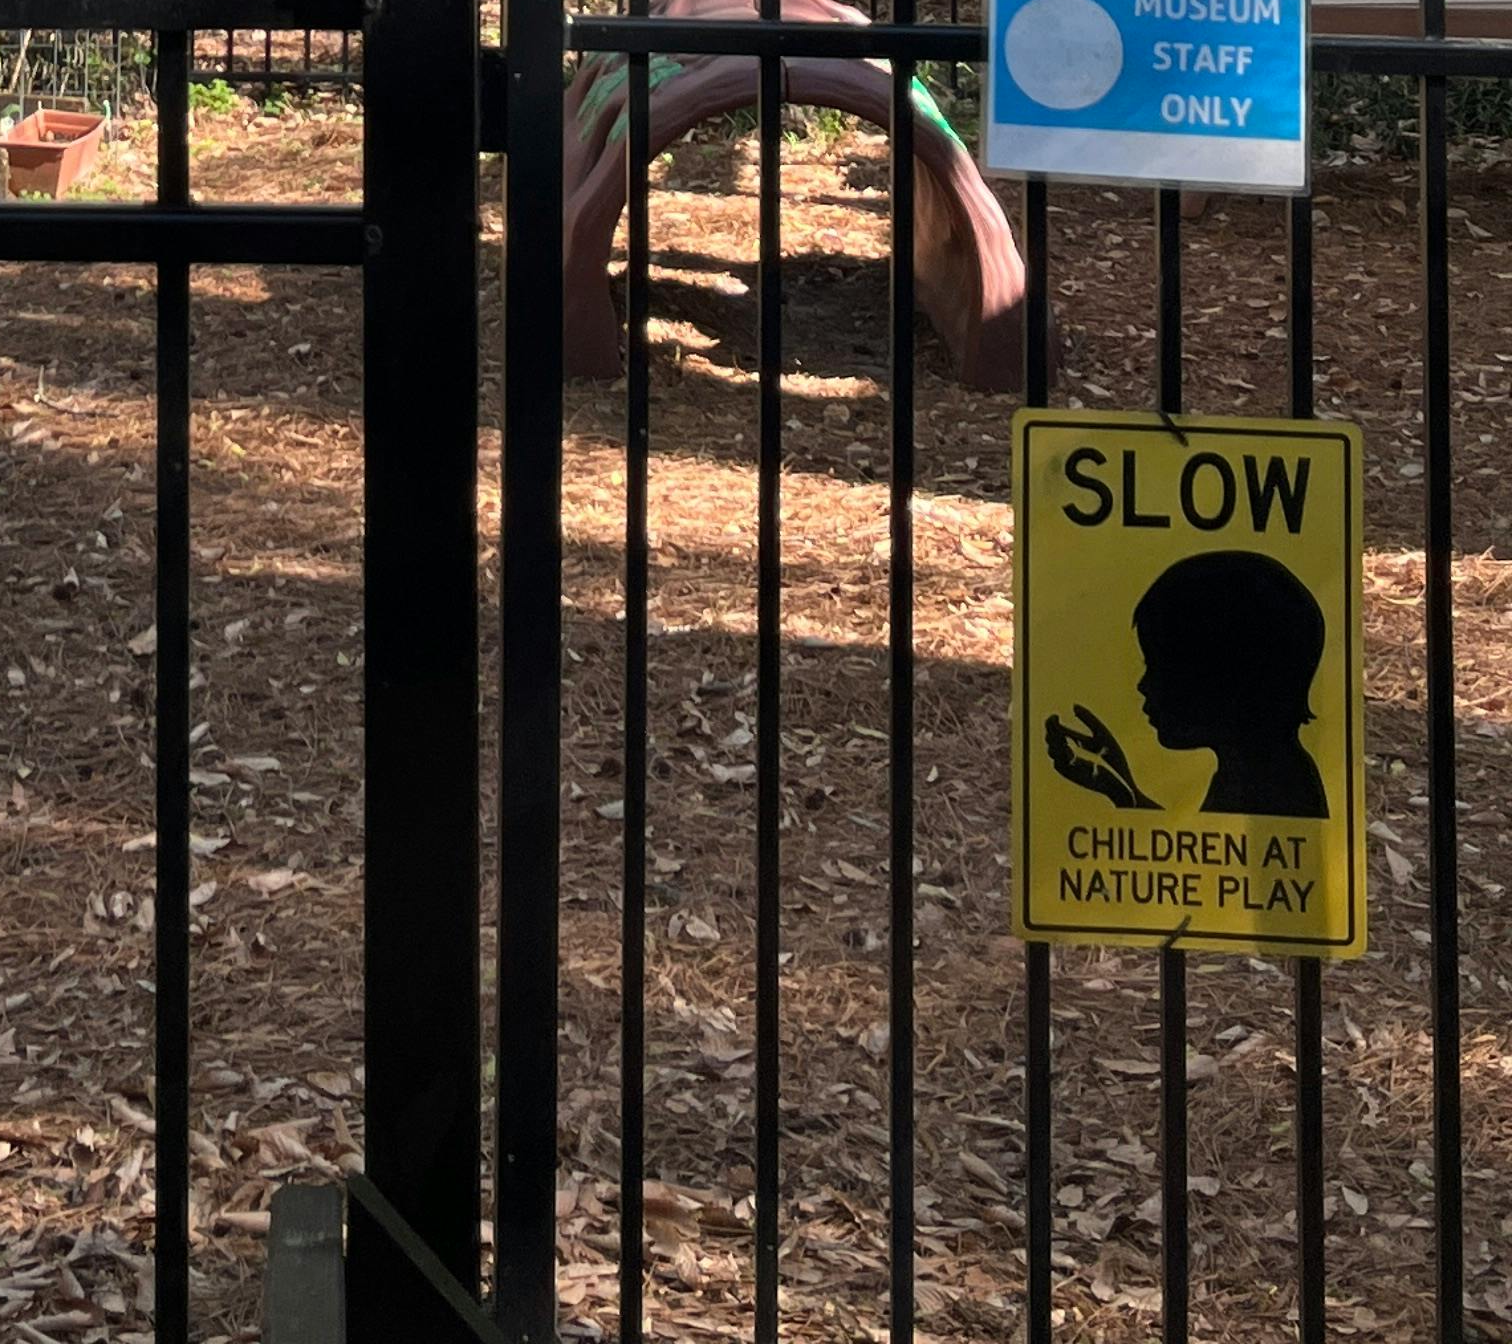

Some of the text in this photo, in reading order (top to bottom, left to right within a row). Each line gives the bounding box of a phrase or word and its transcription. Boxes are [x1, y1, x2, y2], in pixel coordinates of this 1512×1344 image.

[1152, 41, 1253, 75] STAFF
[1161, 93, 1252, 127] ONLY
[1062, 447, 1311, 535] SLOW
[1067, 826, 1307, 869] CHILDREN AT
[1059, 868, 1315, 913] NATURE PLAY
